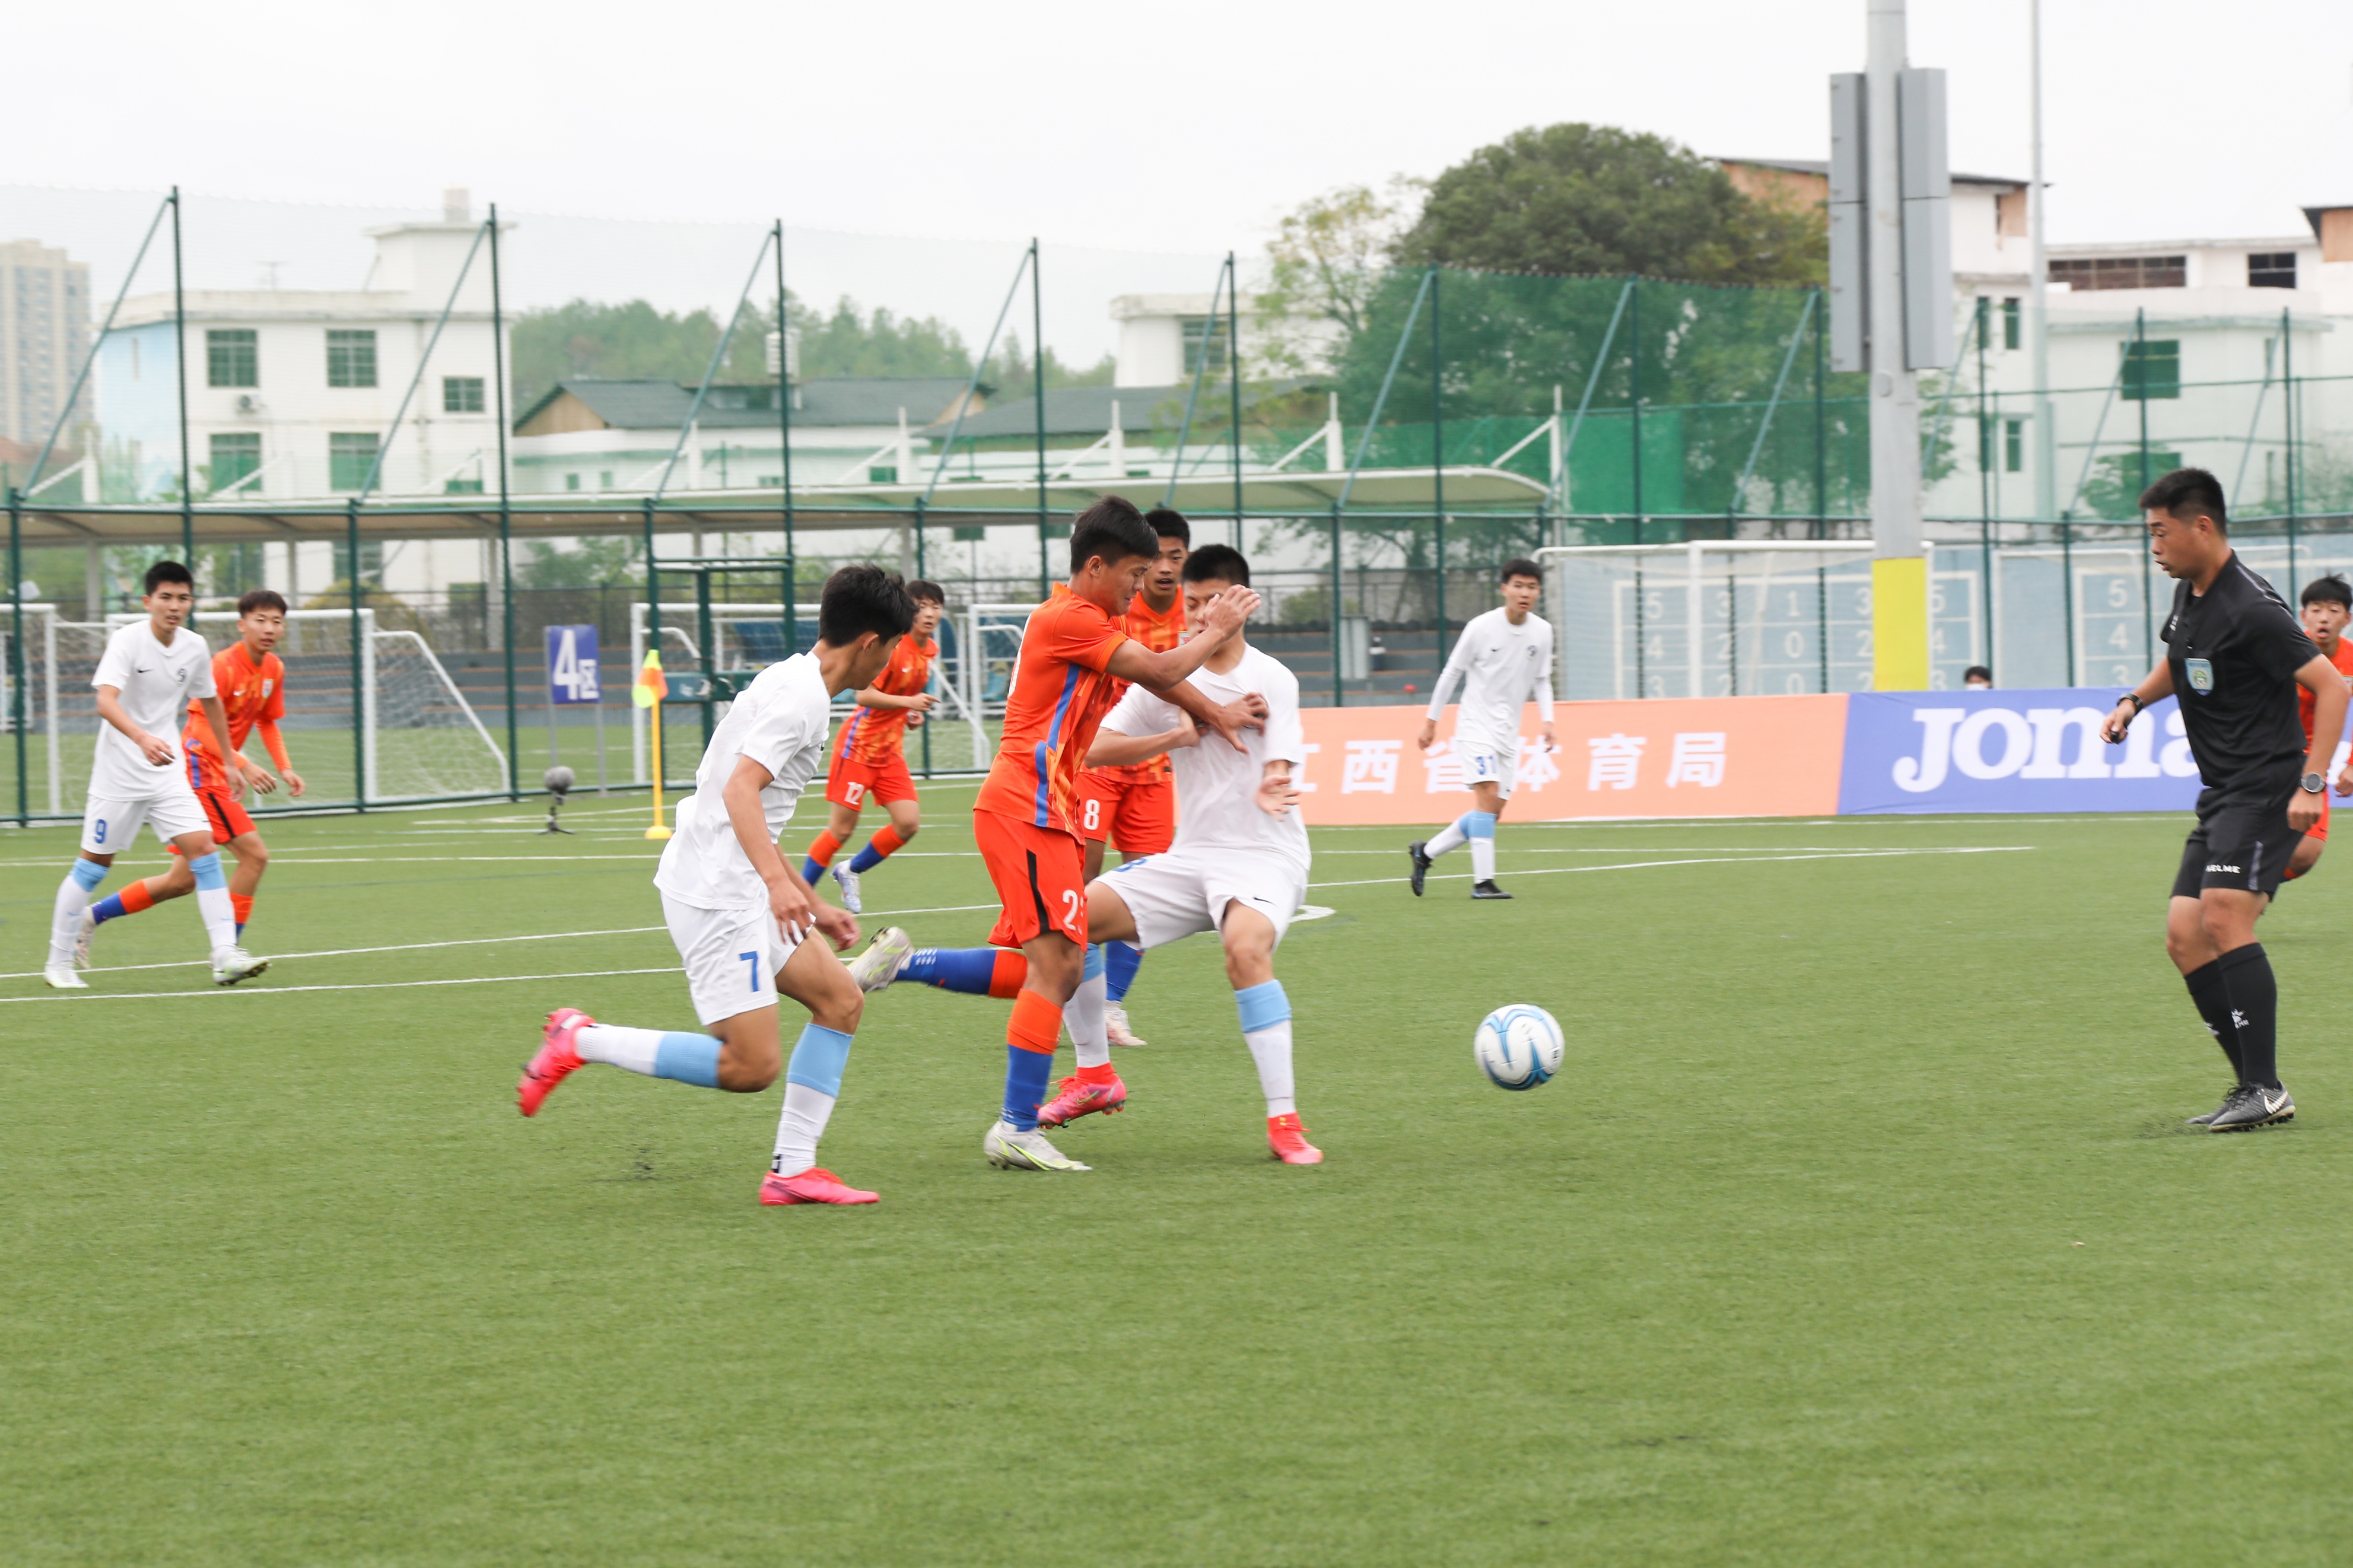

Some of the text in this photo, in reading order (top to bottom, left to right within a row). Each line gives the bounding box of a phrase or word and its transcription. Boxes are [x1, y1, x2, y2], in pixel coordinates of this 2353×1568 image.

[1645, 591, 1664, 619] 5
[1786, 590, 1801, 618] 1
[1855, 587, 1874, 615] 3
[2108, 579, 2128, 608] 5
[1646, 634, 1665, 660] 4
[1784, 631, 1805, 659] 0
[1856, 629, 1874, 657] 2
[2108, 623, 2129, 651] 4
[553, 629, 600, 701] 4区
[1476, 754, 1498, 775] 31
[845, 781, 864, 806] 12
[1083, 799, 1100, 831] 8
[94, 819, 107, 844] 9
[1062, 889, 1085, 936] 2
[737, 950, 760, 993] 7
